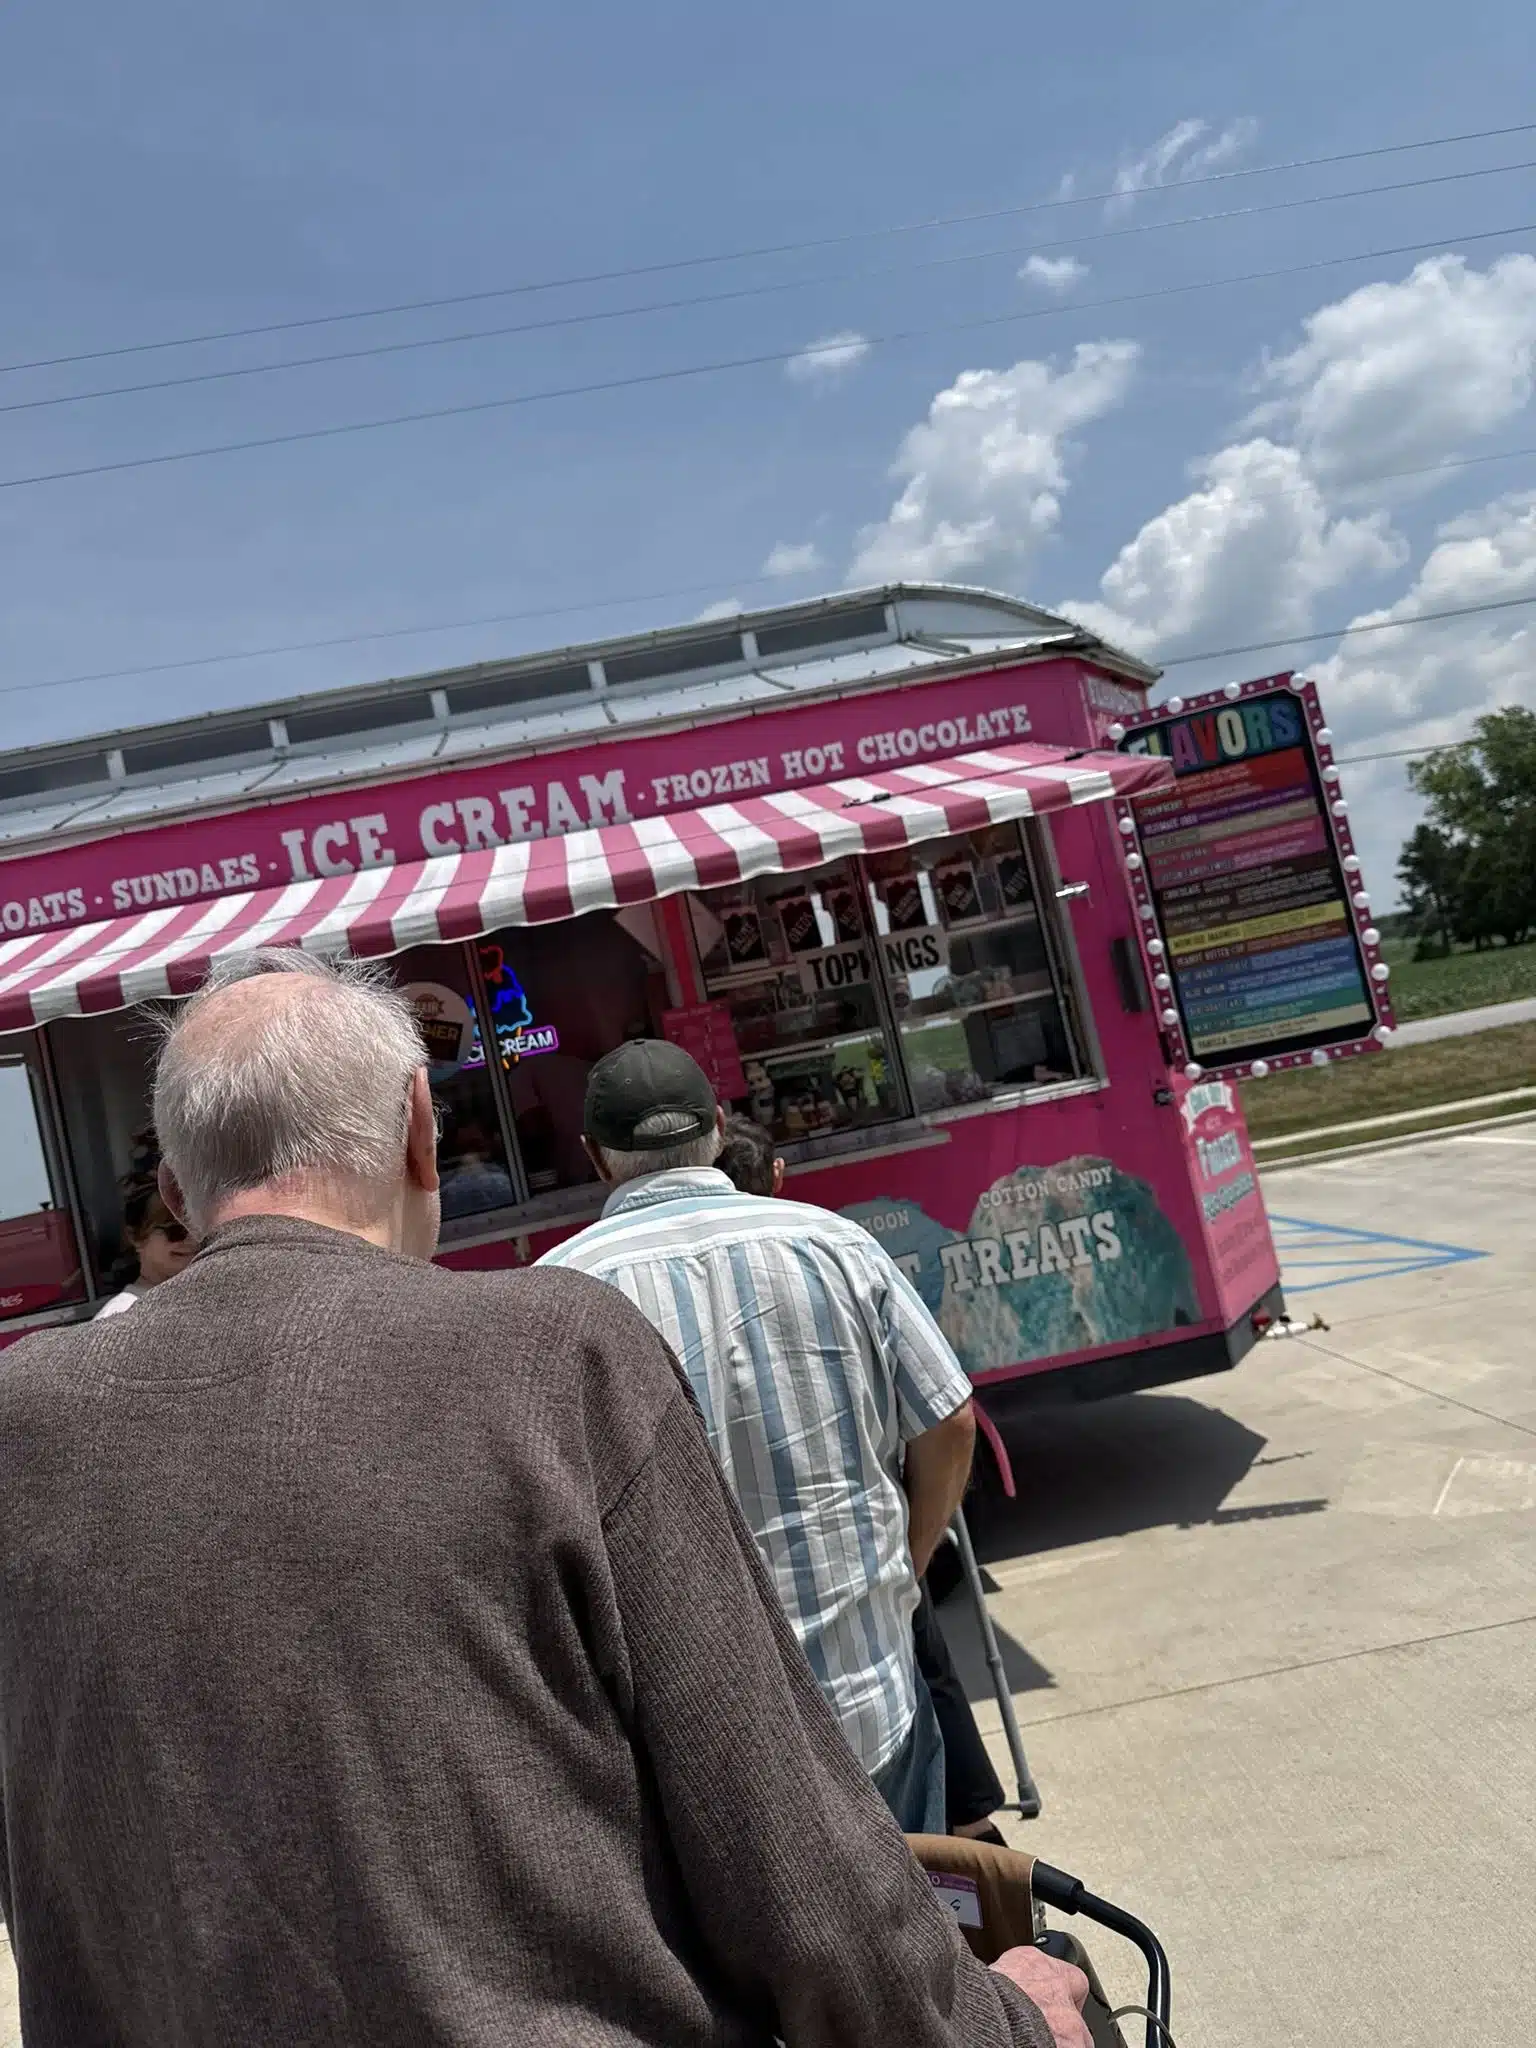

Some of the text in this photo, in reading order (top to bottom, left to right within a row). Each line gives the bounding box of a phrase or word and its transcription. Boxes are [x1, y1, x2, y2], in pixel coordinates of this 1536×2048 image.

[111, 853, 261, 910] SUNDAES
[281, 813, 396, 884] ICE
[419, 769, 634, 858] CREAM
[652, 756, 771, 807] FROZEN
[781, 743, 845, 780] HOT
[856, 704, 1032, 764] CHOCOLATE
[807, 934, 941, 990] TOPNGS
[979, 1166, 1114, 1210] COTTON CANDY
[940, 1210, 1122, 1294] TREATS
